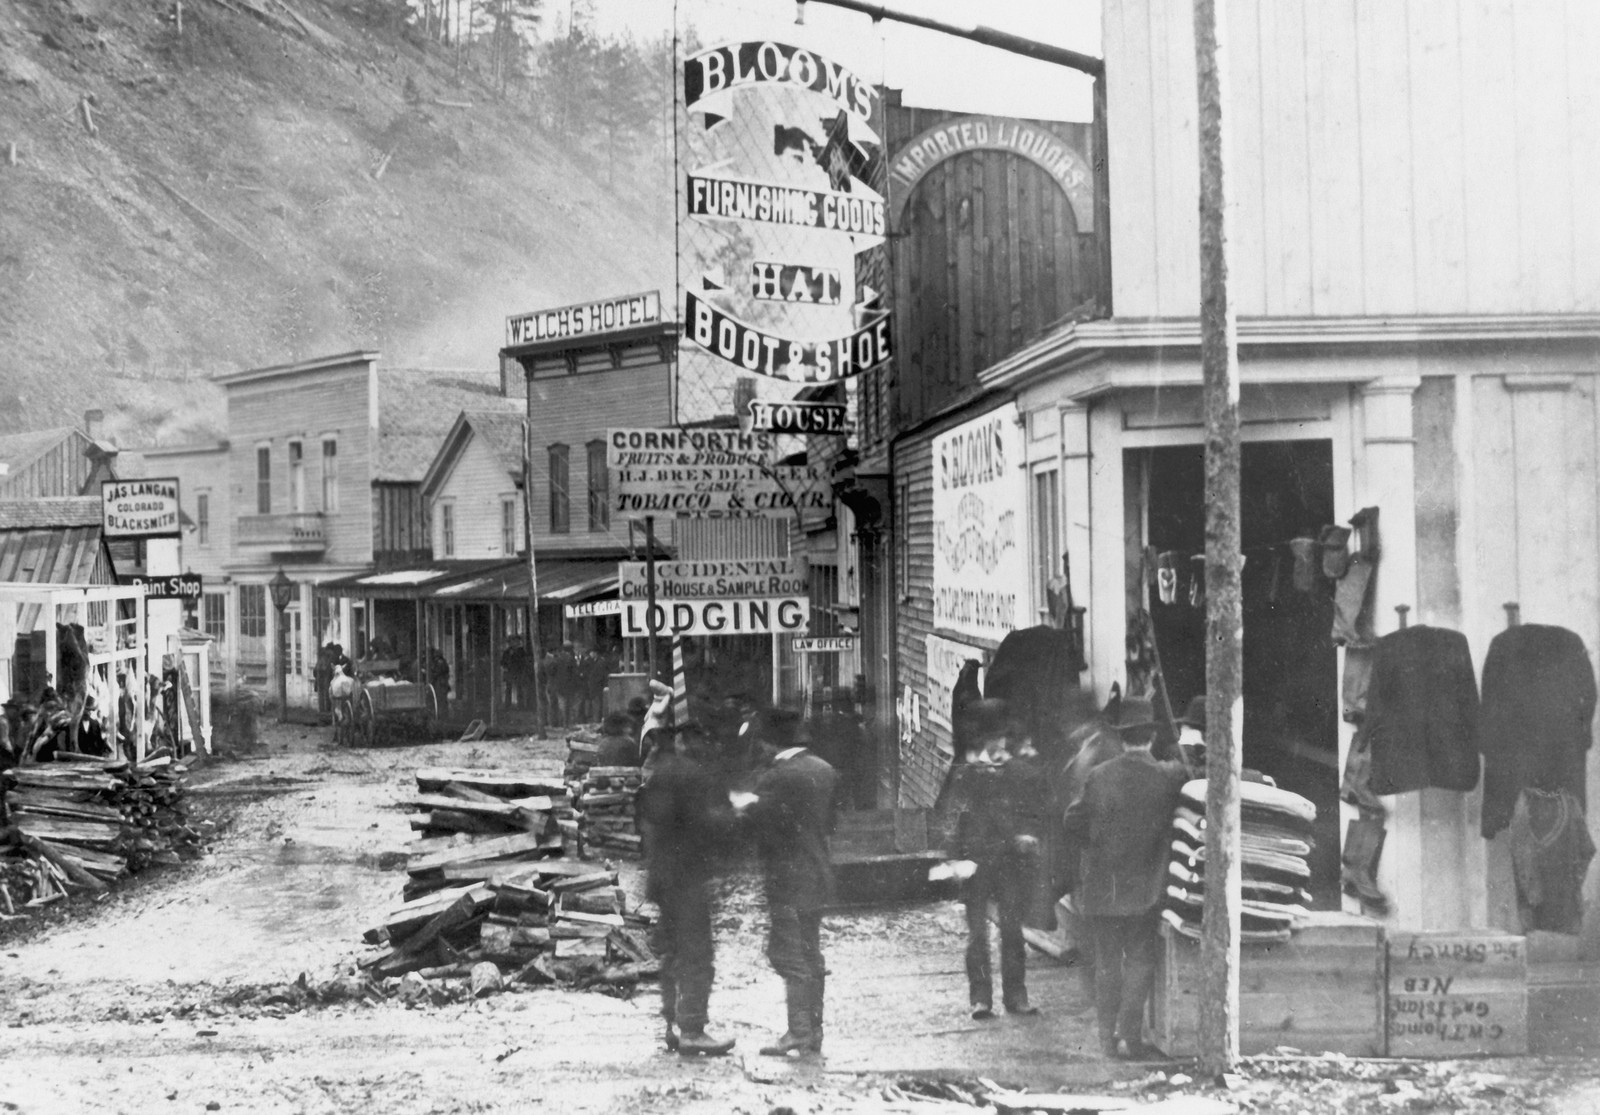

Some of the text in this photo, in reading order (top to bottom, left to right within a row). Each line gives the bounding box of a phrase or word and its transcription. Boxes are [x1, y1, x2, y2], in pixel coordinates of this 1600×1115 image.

[696, 41, 873, 122] BLOOM'S
[891, 122, 988, 187] IMPORTED
[693, 178, 885, 236] FURNISHING GOODS
[510, 306, 584, 344] WELCH'S
[695, 300, 890, 383] BOOT & SHOE
[616, 452, 675, 466] FRUITS
[676, 453, 691, 466] &
[131, 484, 175, 499] LANGAN
[117, 502, 164, 513] COLORADO
[615, 492, 711, 512] TOBACCO
[728, 493, 746, 509] &
[170, 578, 200, 598] Shop
[663, 579, 705, 597] HOUSE
[716, 578, 766, 596] SAMPLE
[794, 638, 852, 649] LAW OFFICE
[1404, 976, 1454, 996] NEB
